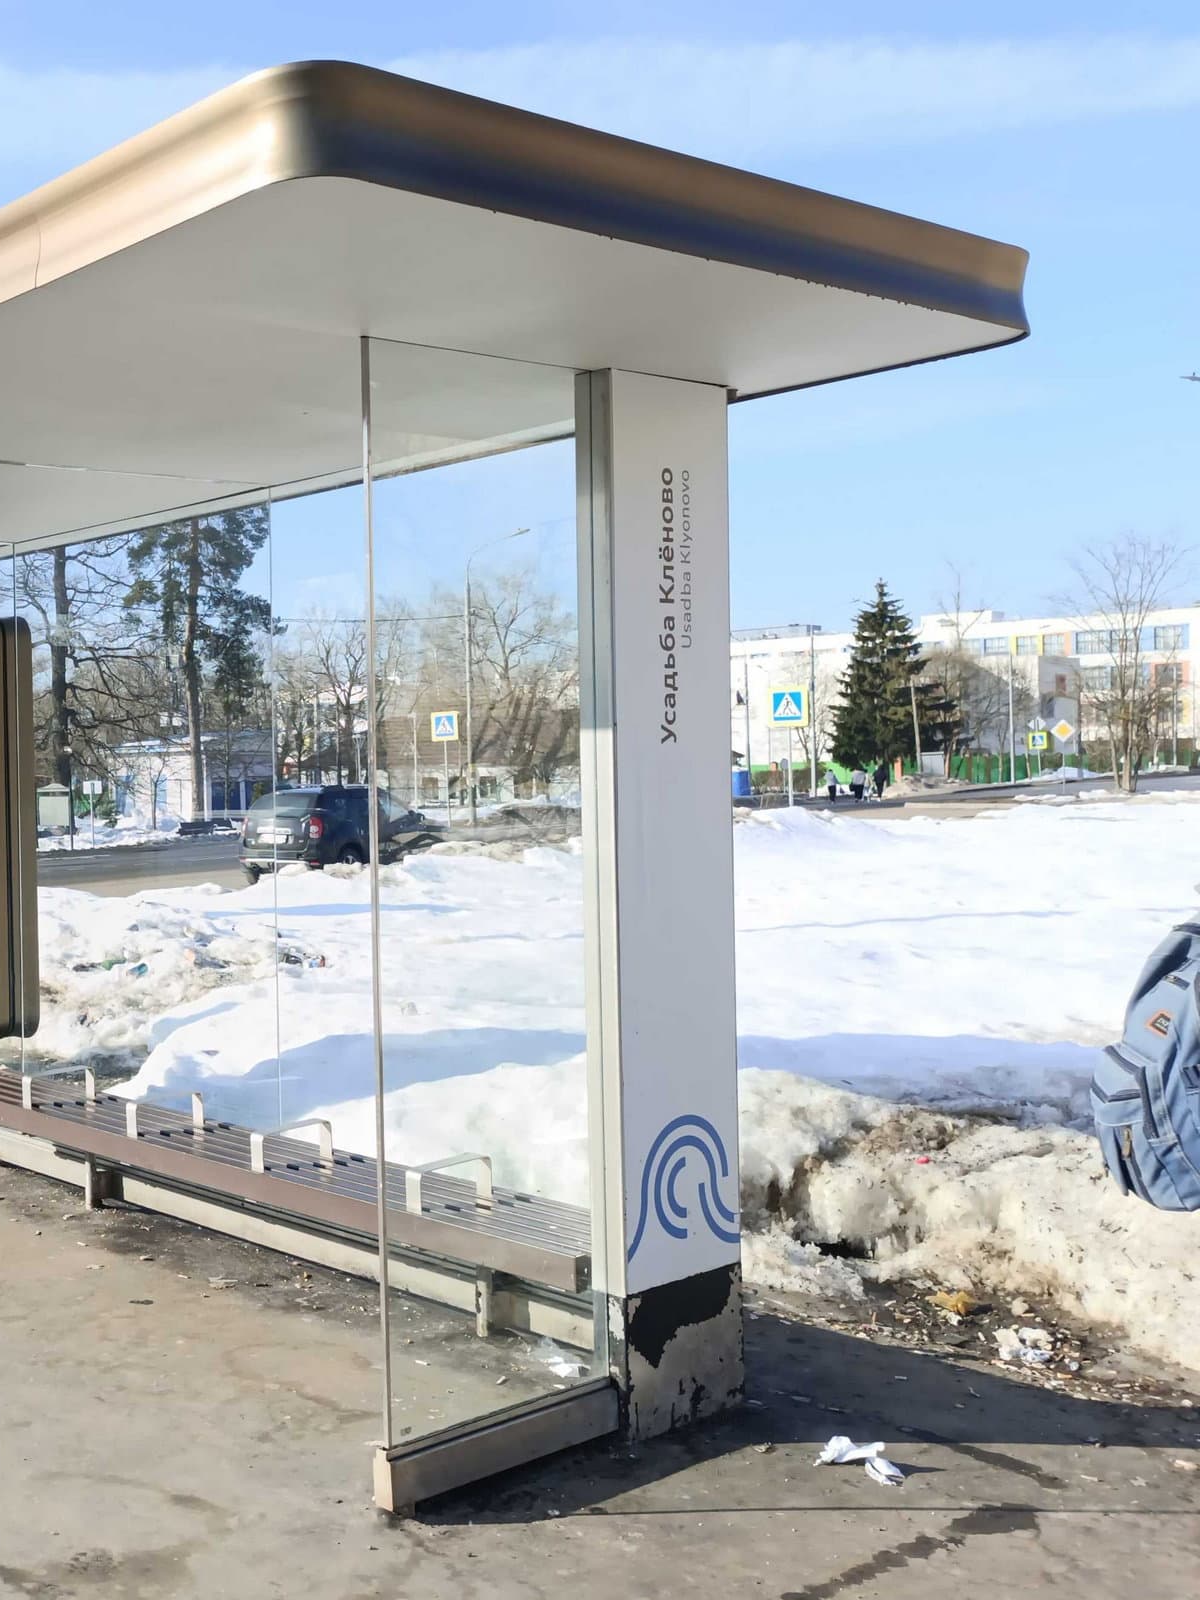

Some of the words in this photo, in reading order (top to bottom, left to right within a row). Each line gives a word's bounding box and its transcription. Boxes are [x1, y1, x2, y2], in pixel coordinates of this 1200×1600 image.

[659, 467, 675, 604] Клёново
[680, 470, 693, 564] Klyonovo
[680, 571, 692, 648] Usadba
[659, 615, 678, 744] Усадьба
